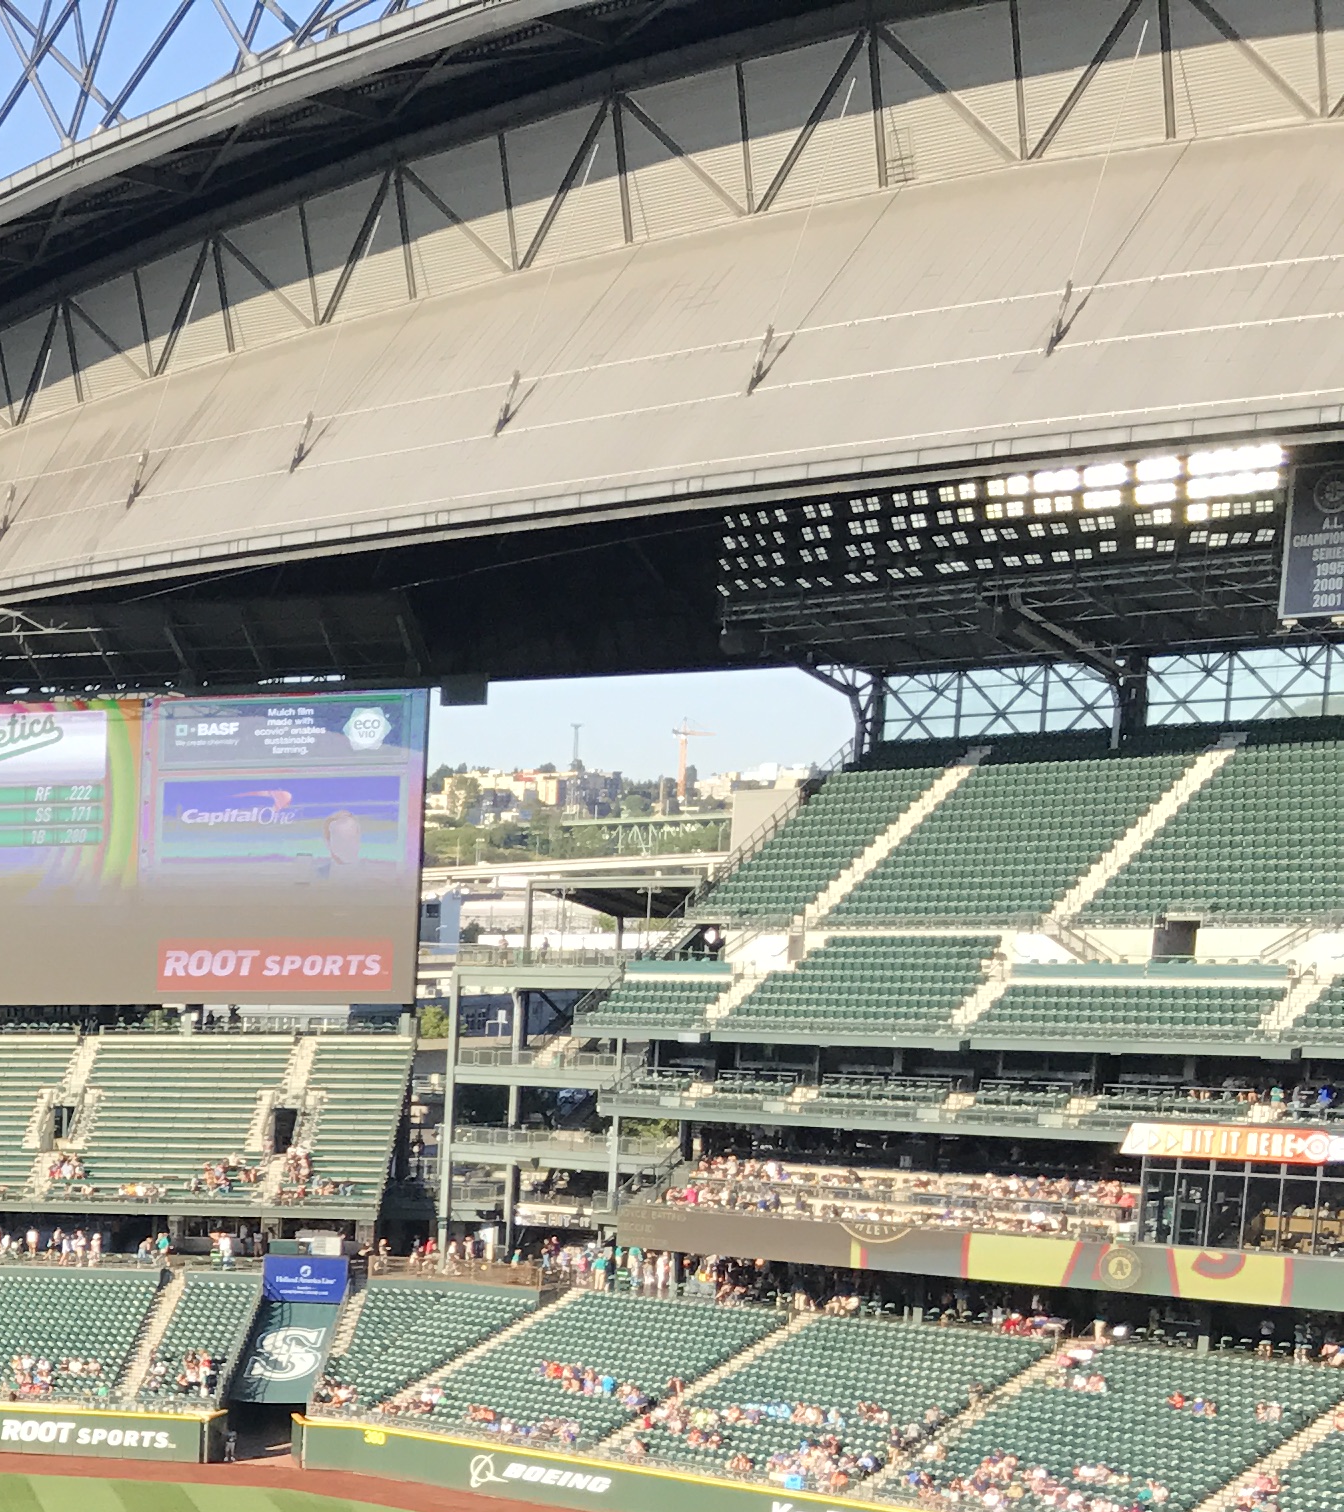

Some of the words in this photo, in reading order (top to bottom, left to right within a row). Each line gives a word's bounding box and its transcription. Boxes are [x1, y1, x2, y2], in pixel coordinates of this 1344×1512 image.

[1316, 562, 1344, 576] 1995
[1313, 579, 1343, 592] 2000
[1313, 594, 1342, 607] 2001
[268, 708, 296, 717] Mulch
[298, 708, 314, 716] film
[267, 717, 292, 726] made
[294, 717, 314, 725] with
[353, 719, 381, 730] eco
[198, 722, 239, 735] BASF
[291, 726, 326, 735] enables
[264, 736, 315, 745] sustainable
[35, 787, 52, 802] RF
[65, 786, 92, 800] .222
[35, 808, 52, 822] SS
[65, 806, 92, 821] .171
[32, 830, 46, 844] 1B
[164, 950, 260, 977] ROOT
[263, 955, 381, 976] SPORTS
[1181, 1129, 1215, 1154] HIT
[1220, 1131, 1241, 1155] IT
[1245, 1132, 1296, 1158] HERE
[1, 1419, 75, 1443] ROOT
[77, 1427, 169, 1449] SPORTS
[502, 1462, 612, 1493] BOEING
